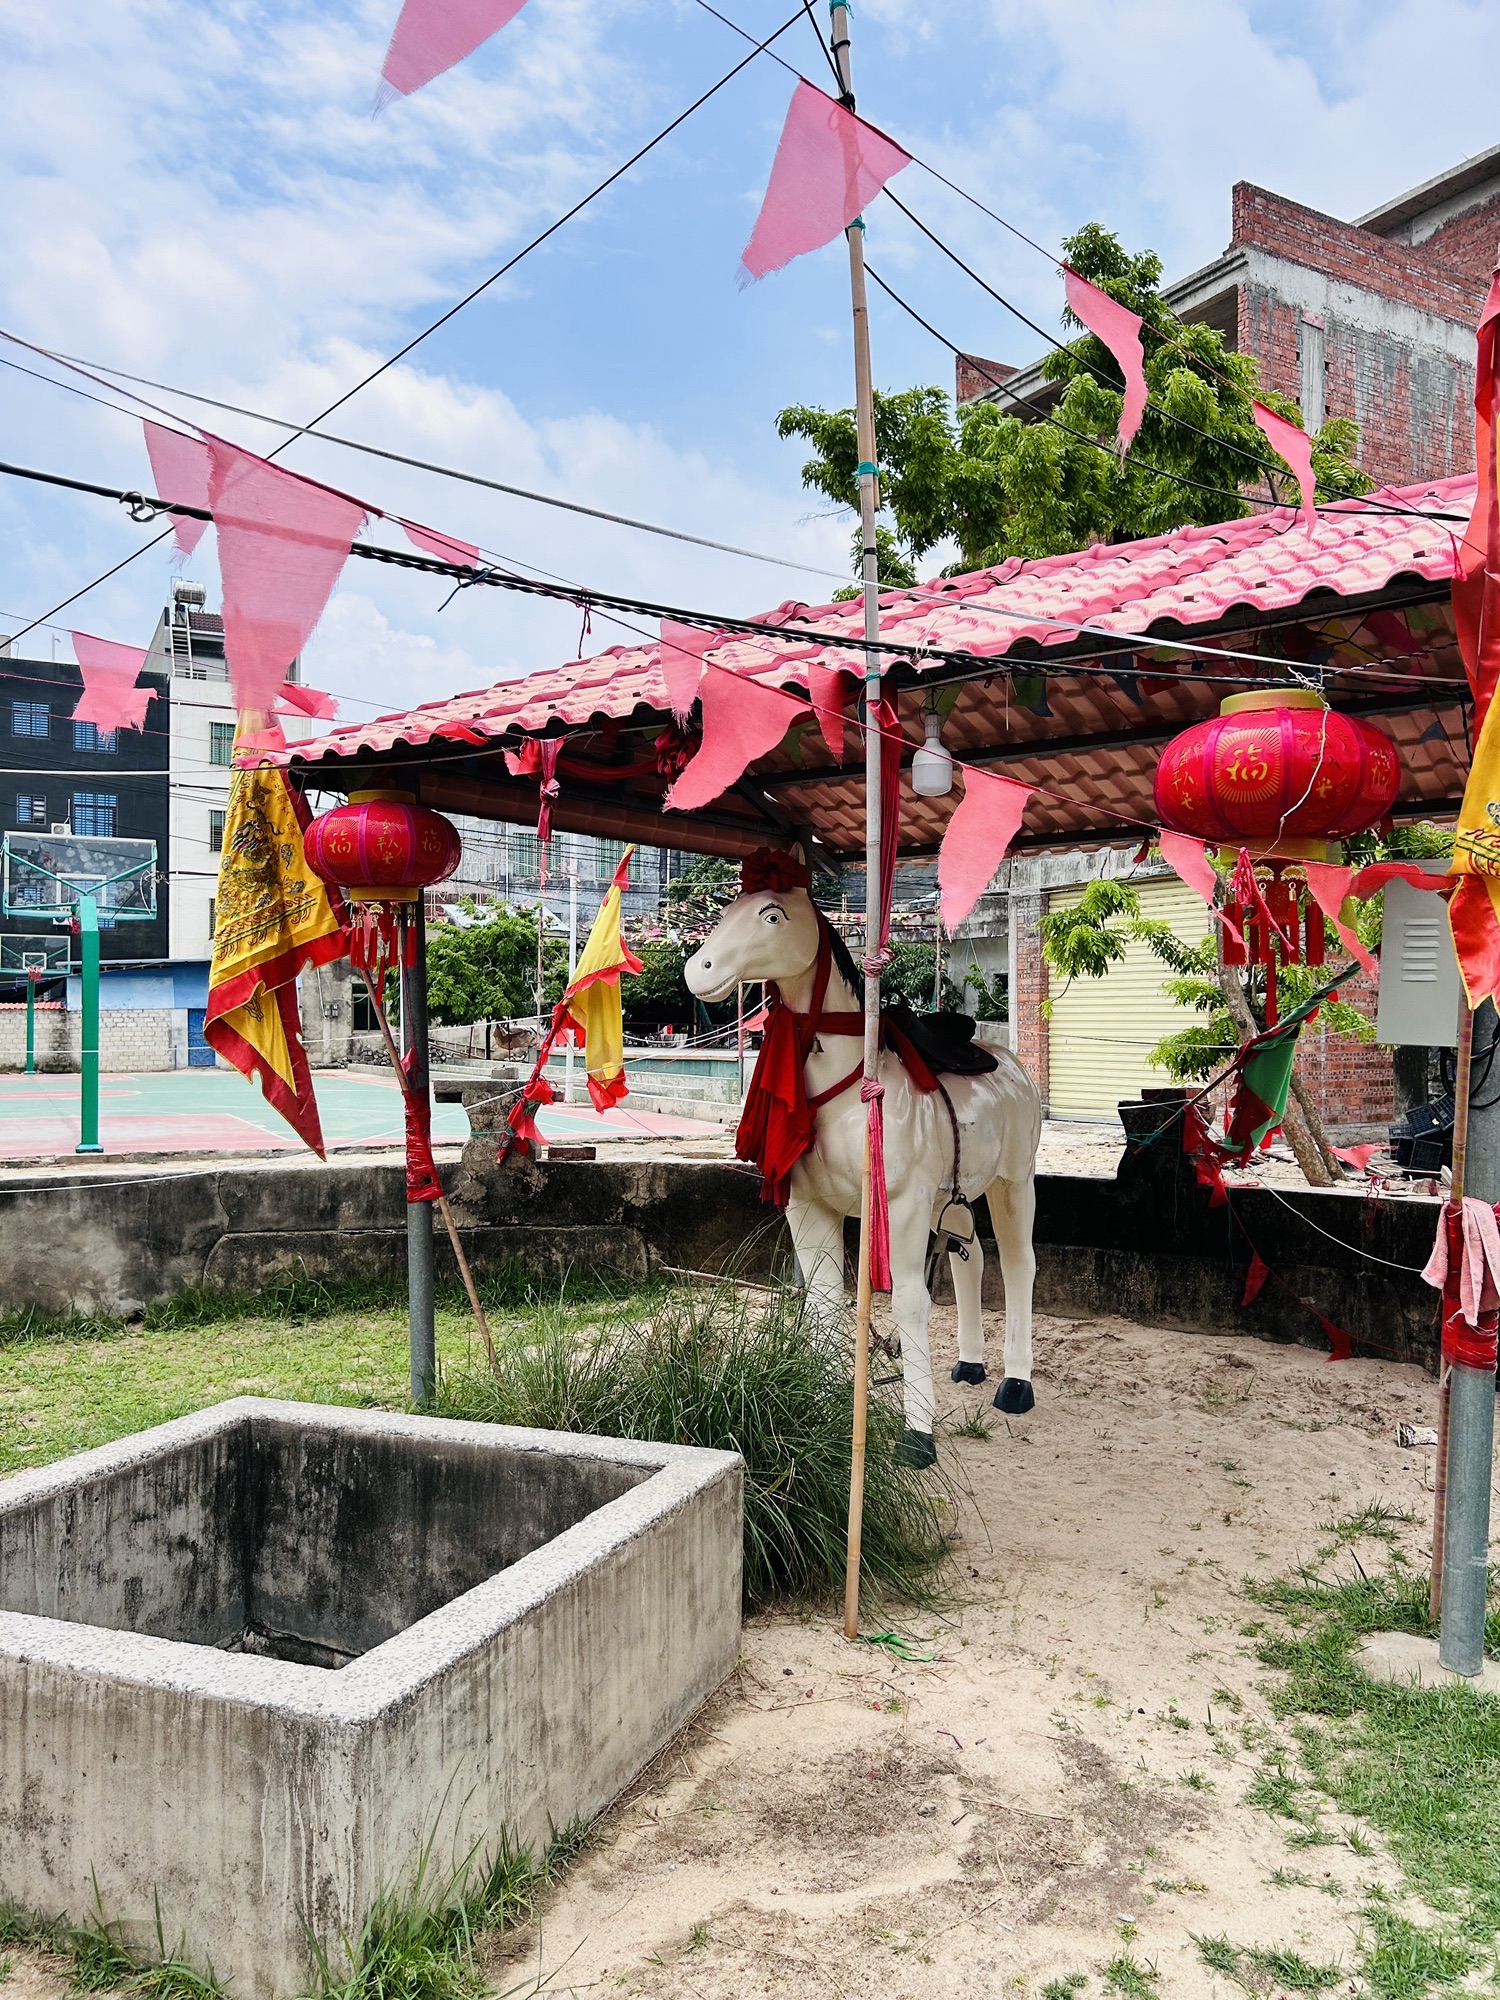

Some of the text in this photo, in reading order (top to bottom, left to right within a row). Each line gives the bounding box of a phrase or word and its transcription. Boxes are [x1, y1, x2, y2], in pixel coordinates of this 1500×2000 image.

[1225, 743, 1268, 782] 福
[328, 829, 352, 853] 福
[421, 828, 442, 853] 福
